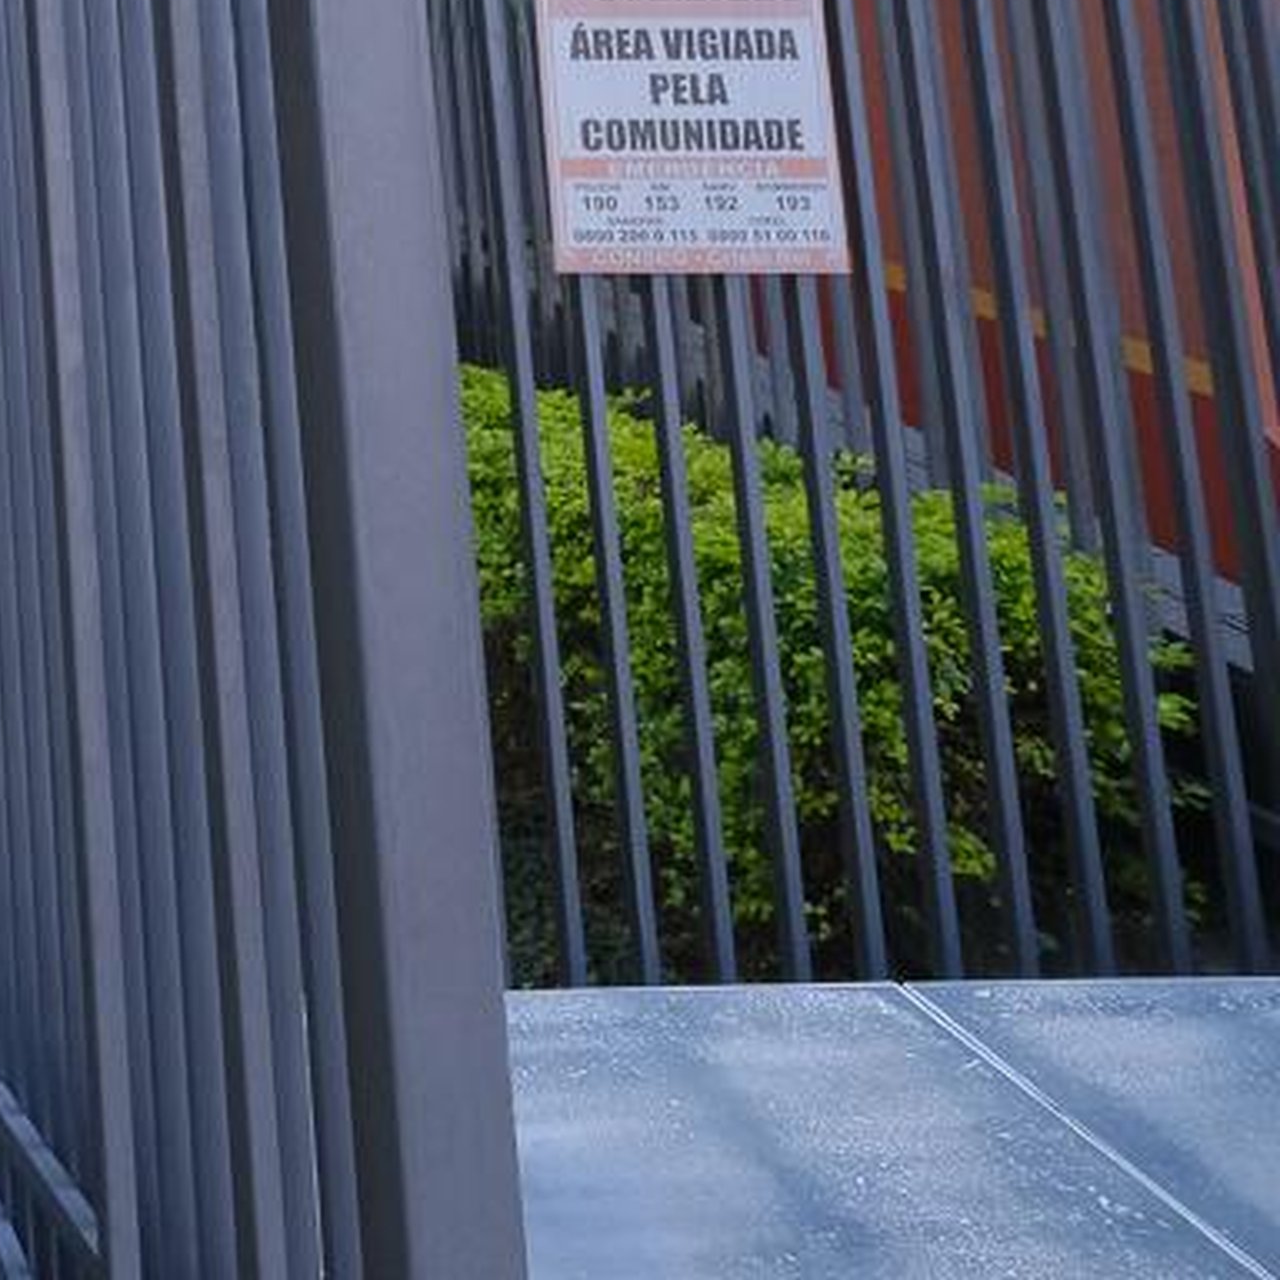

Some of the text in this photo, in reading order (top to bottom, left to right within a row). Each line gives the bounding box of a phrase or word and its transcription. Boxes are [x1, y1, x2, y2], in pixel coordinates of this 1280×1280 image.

[570, 22, 800, 61] ÁREA VIGIADA
[649, 72, 730, 106] PELA
[580, 118, 805, 152] COMUNIDADE
